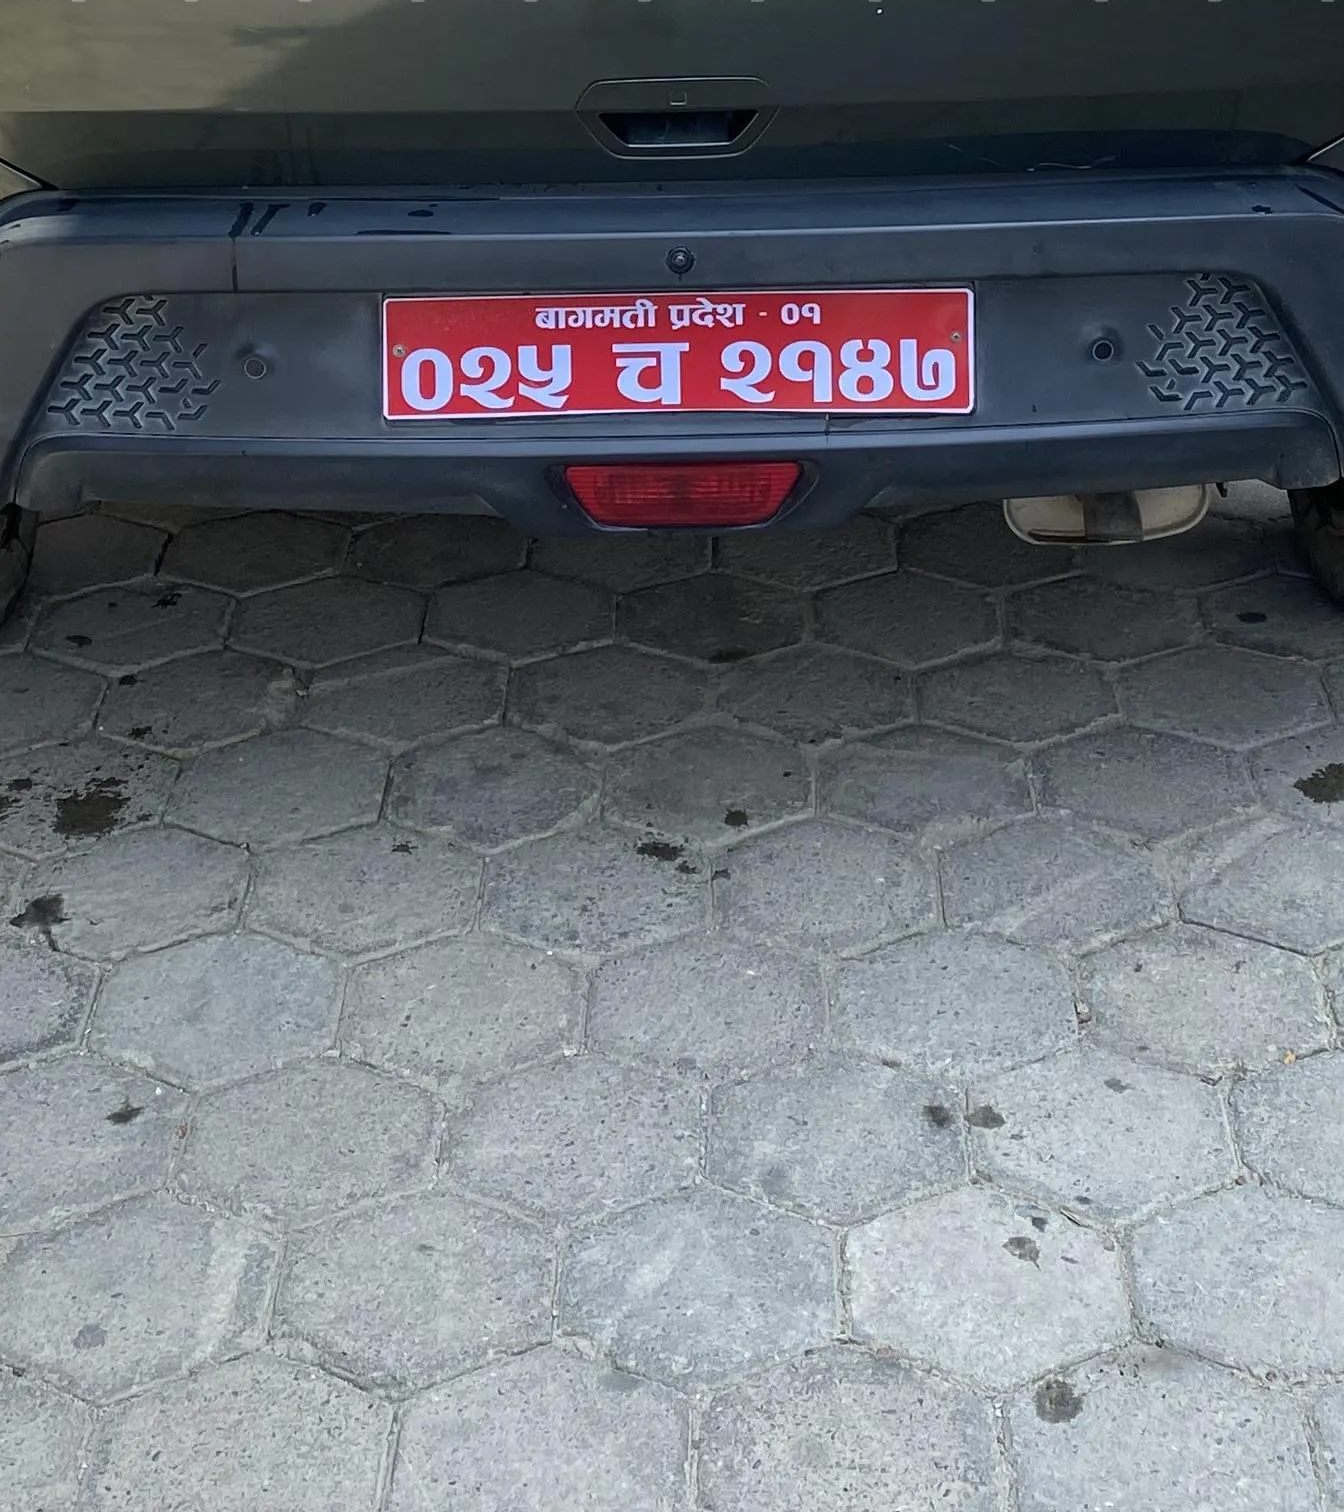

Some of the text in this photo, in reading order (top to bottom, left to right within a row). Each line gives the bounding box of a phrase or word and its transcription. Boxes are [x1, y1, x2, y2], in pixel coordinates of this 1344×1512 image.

[535, 298, 658, 329] बागमती
[668, 298, 746, 330] प्रदेश
[781, 303, 822, 325] ०१
[400, 338, 957, 411] ०२५ च २१४७
